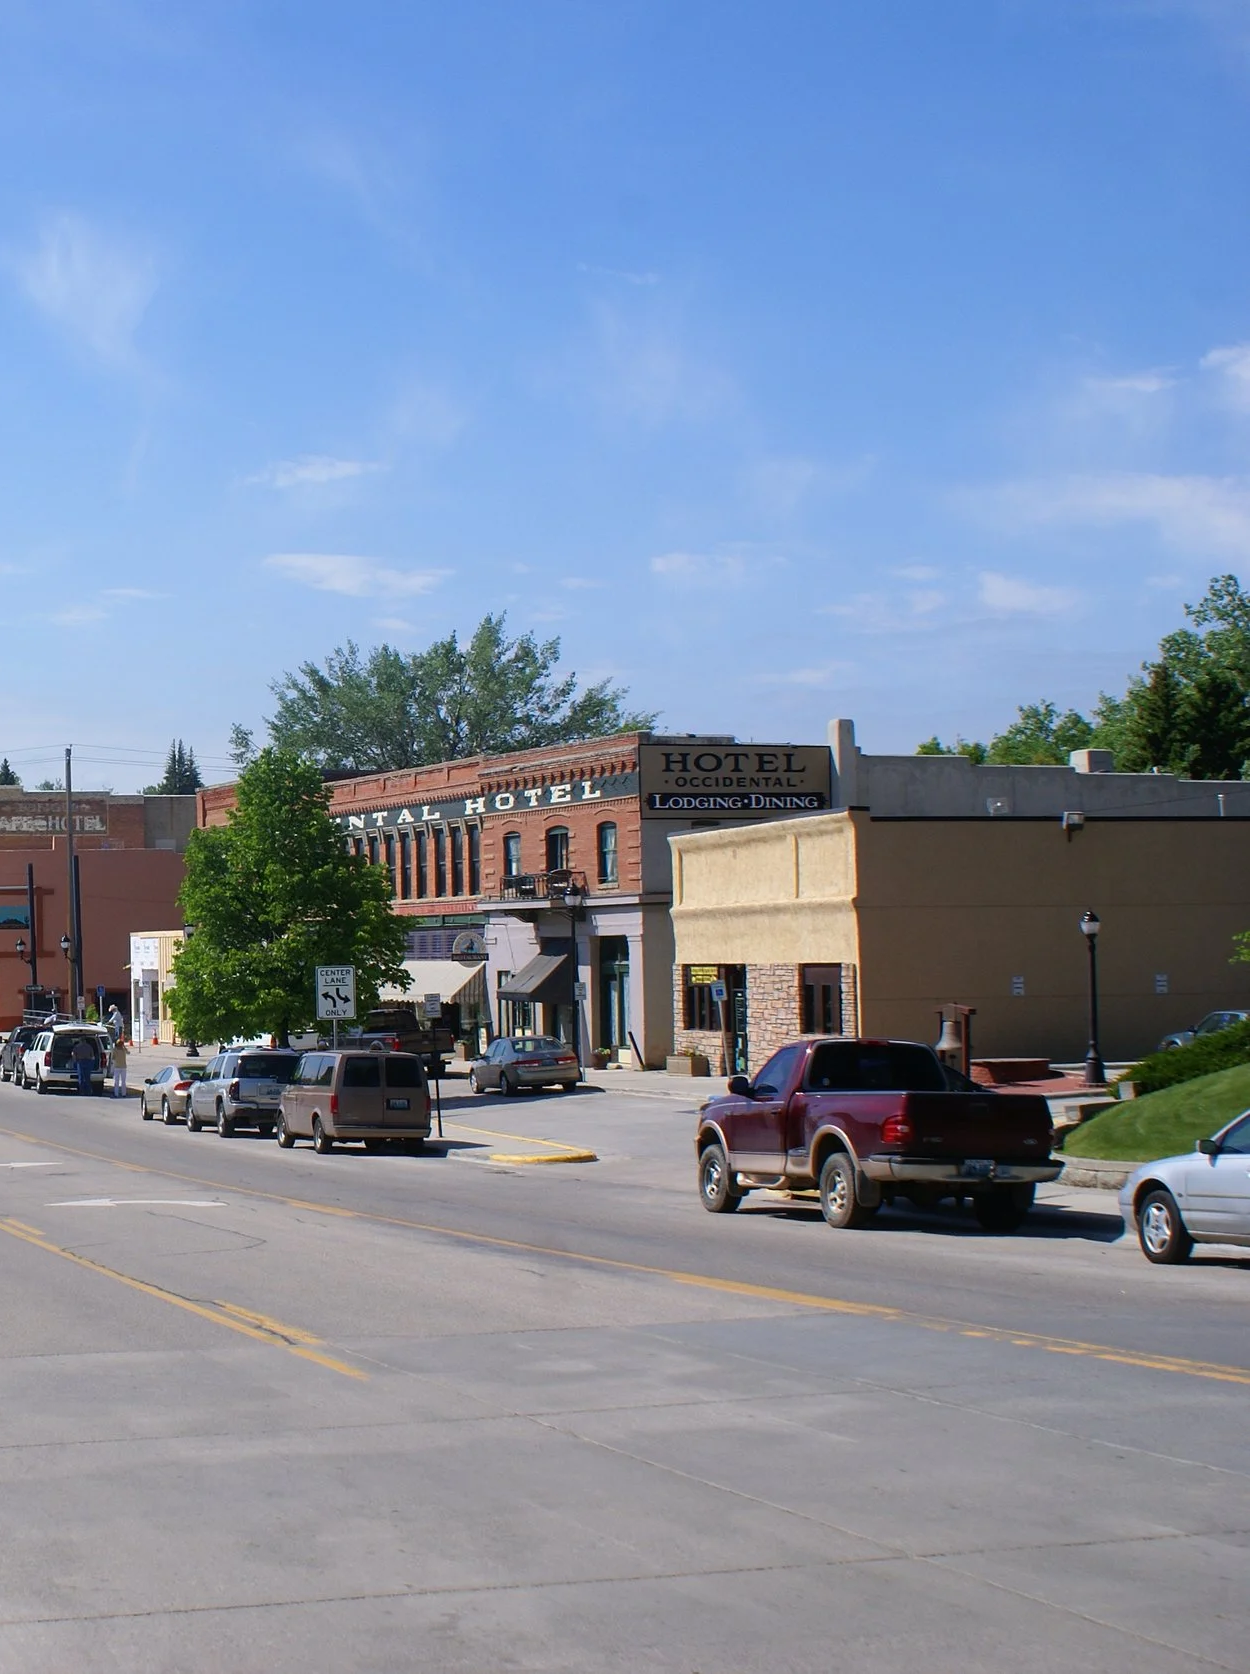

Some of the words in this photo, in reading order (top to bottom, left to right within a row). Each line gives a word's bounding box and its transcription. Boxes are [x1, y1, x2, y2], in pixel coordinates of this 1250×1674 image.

[662, 752, 807, 773] HOTEL
[674, 776, 798, 788] OCCIDENTAL
[464, 780, 601, 815] HOTEL
[320, 969, 351, 977] CENTER
[325, 1009, 348, 1017] ONLY
